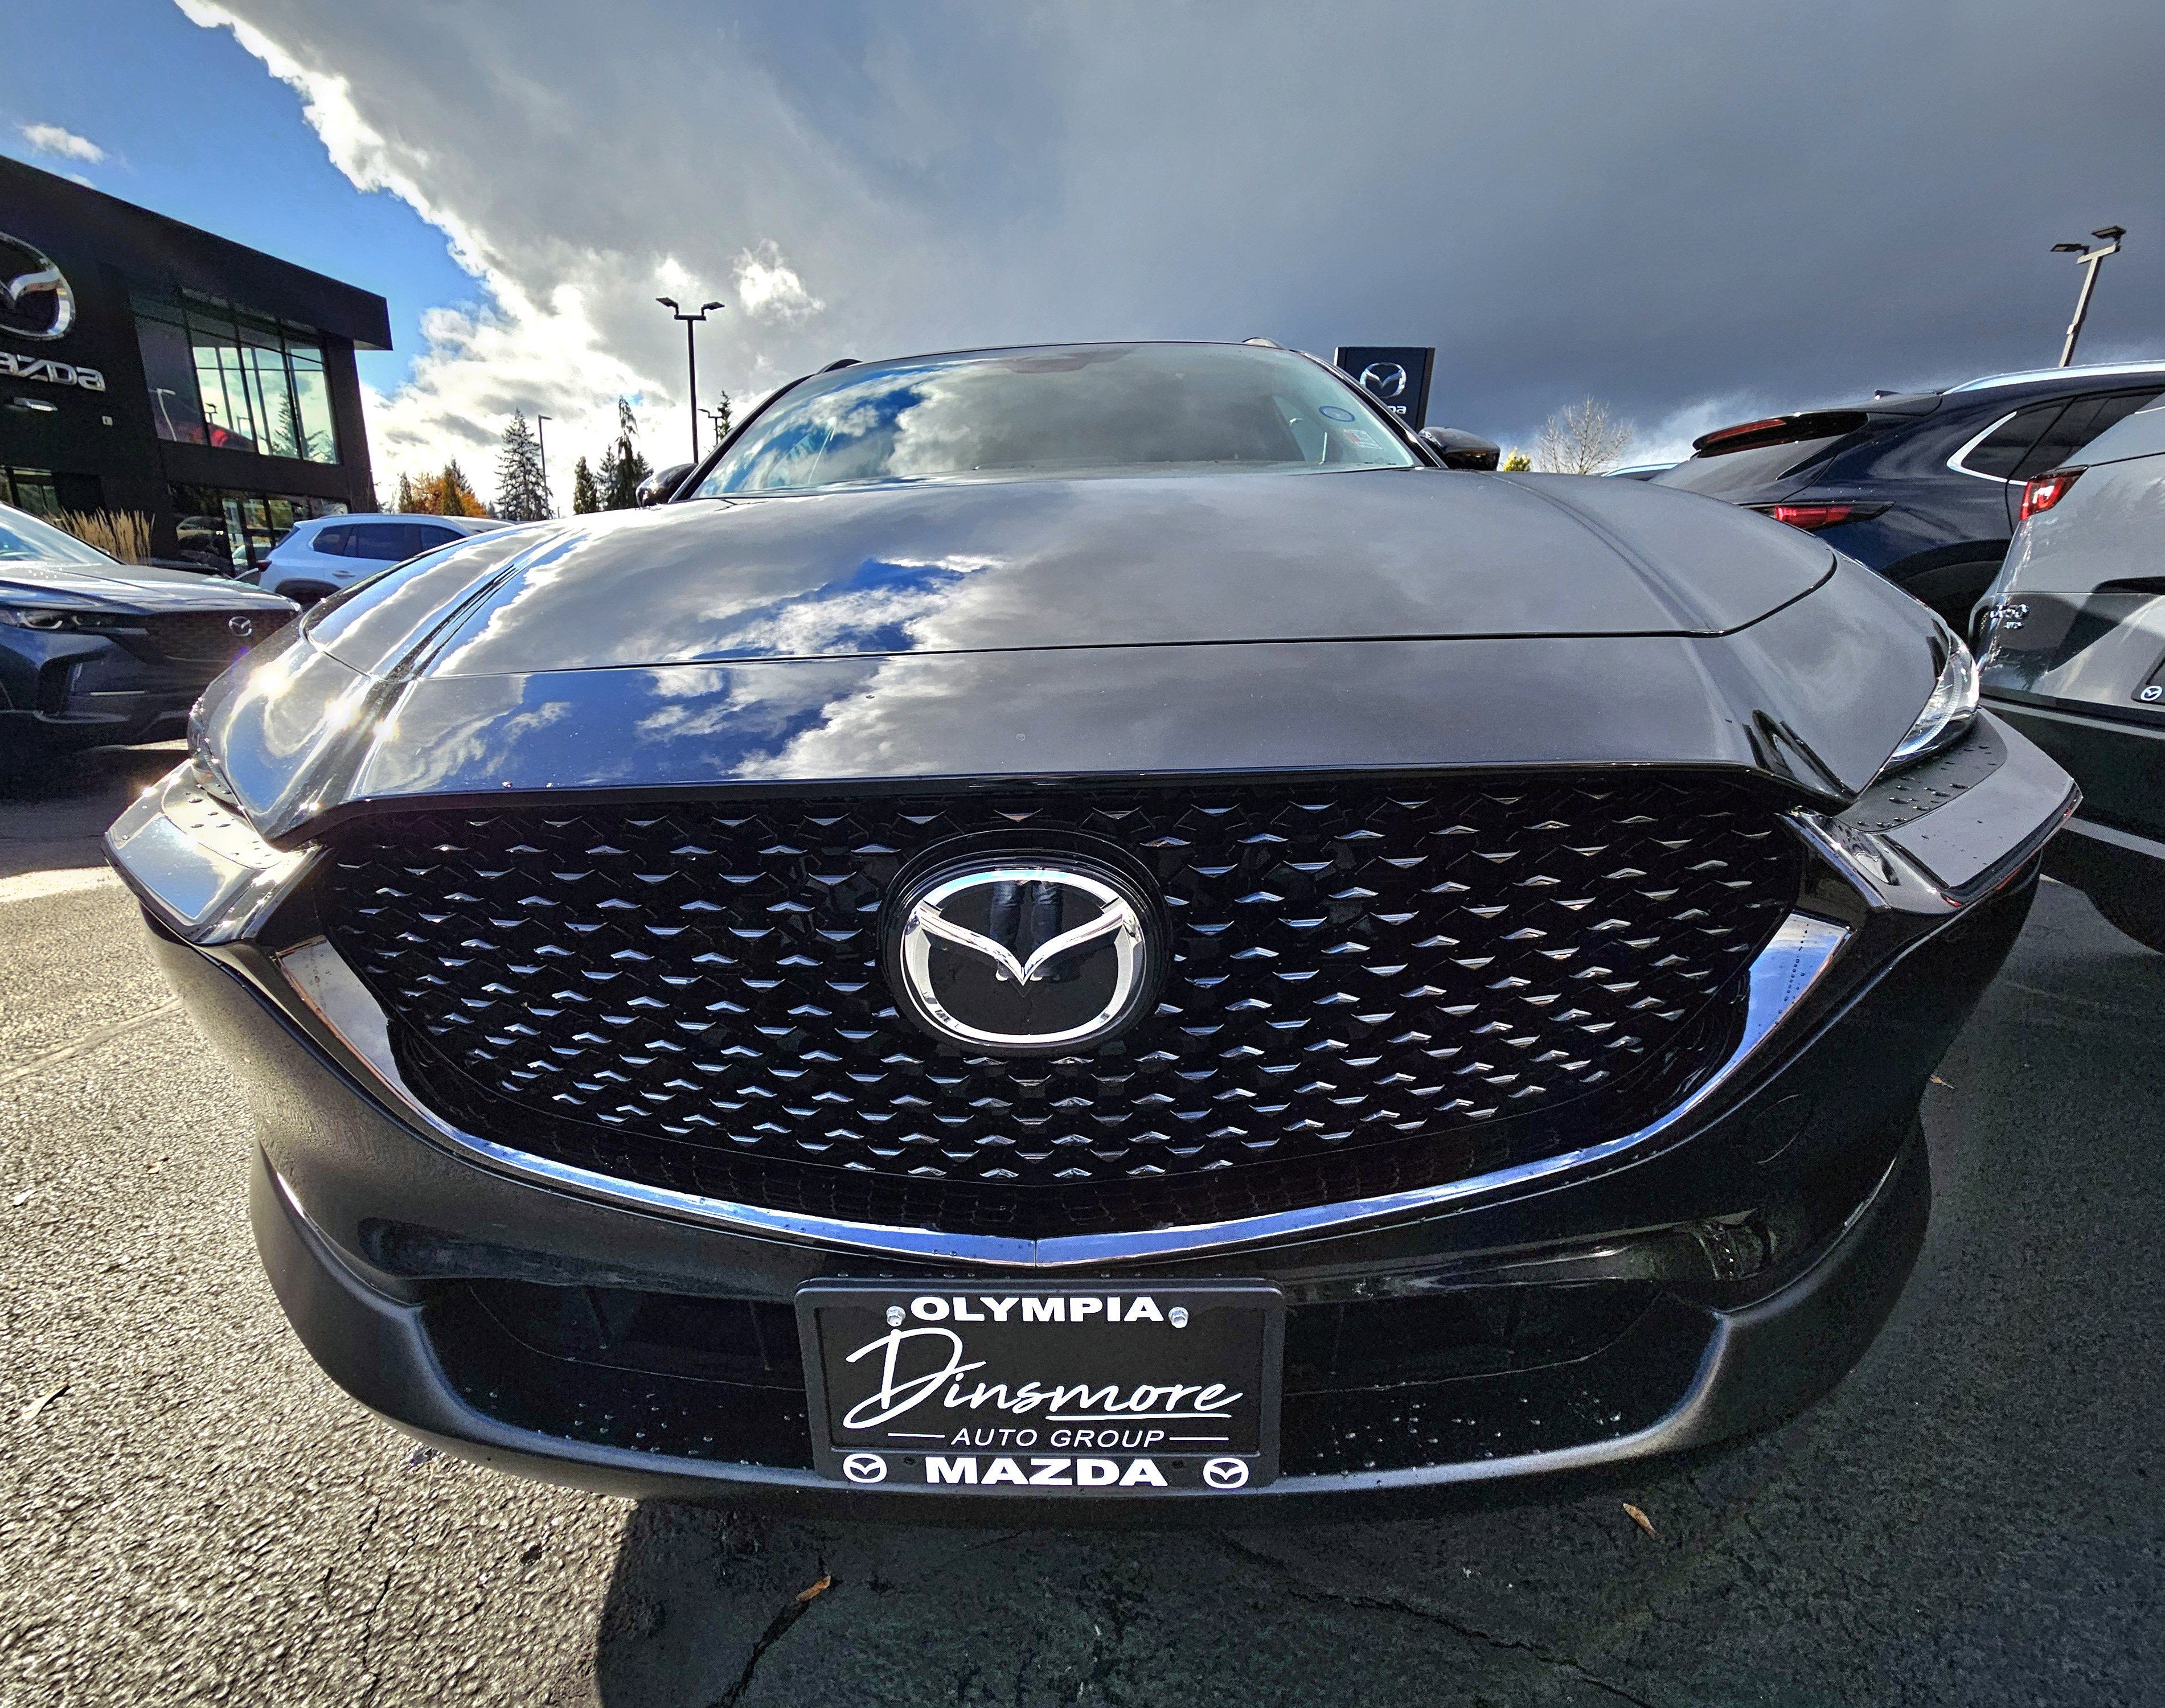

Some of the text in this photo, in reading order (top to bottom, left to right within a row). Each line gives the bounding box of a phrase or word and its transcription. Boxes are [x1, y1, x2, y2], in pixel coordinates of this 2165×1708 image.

[910, 1296, 1164, 1322] OLYMPIA
[843, 1327, 1244, 1429] Dinsmore
[951, 1428, 1164, 1448] AUTO GROUP
[925, 1456, 1168, 1487] MAZDA
